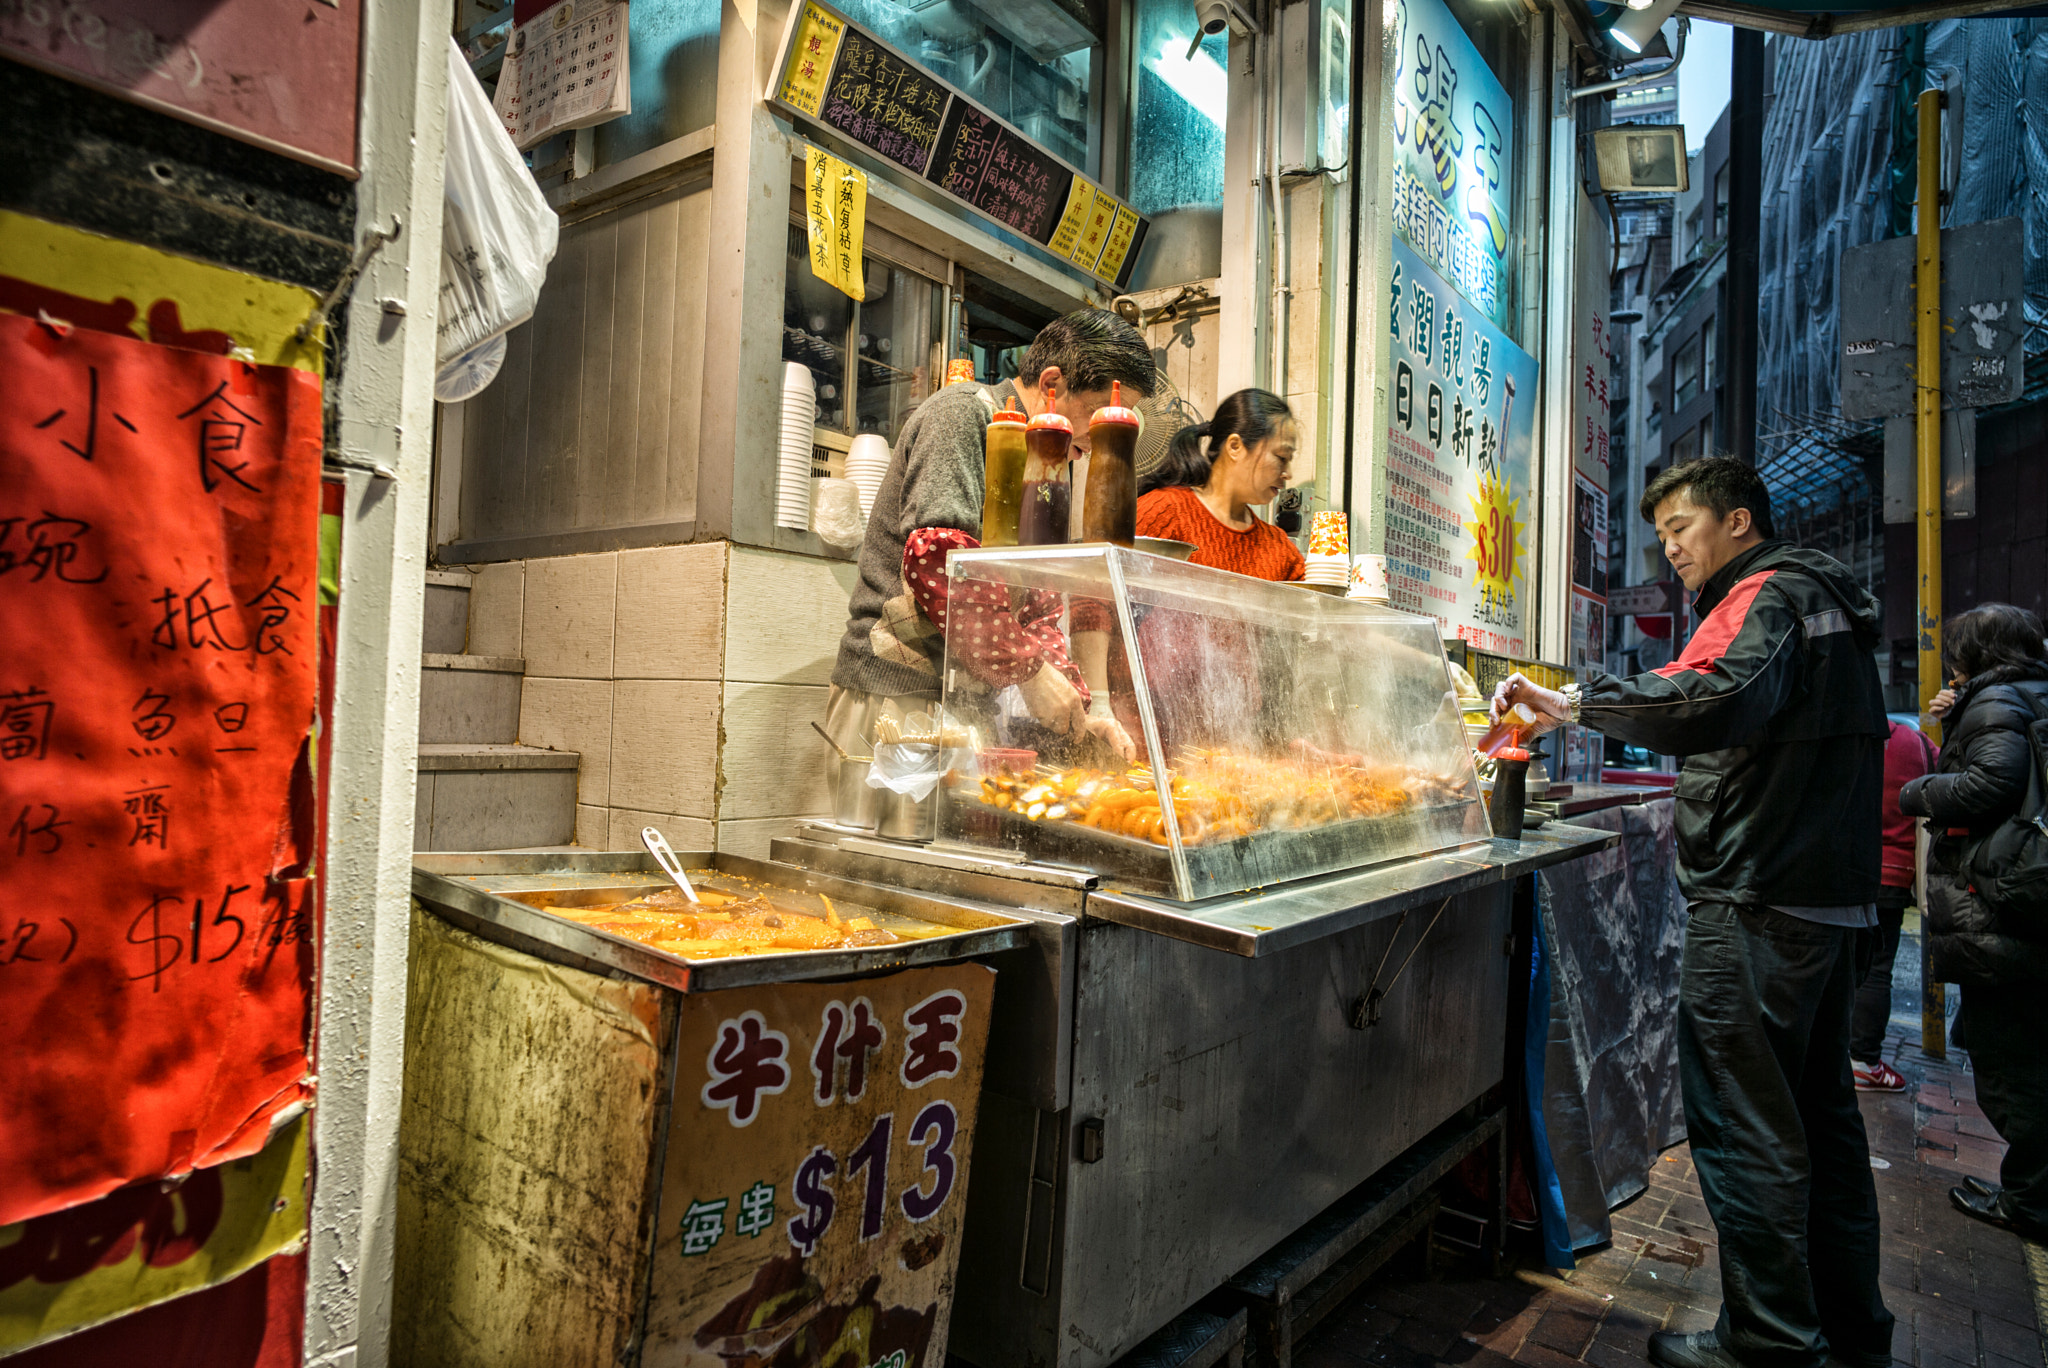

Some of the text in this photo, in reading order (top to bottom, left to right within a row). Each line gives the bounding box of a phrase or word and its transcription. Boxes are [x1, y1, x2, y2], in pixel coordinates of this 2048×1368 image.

[556, 57, 563, 66] 10
[571, 48, 578, 58] 11
[588, 42, 596, 51] 12
[605, 34, 614, 44] 13
[590, 24, 596, 33] 5
[801, 34, 821, 79] 靚湯
[506, 112, 519, 120] 21
[538, 98, 546, 108] 23
[552, 90, 558, 100] 24
[566, 83, 575, 92] 25
[584, 77, 594, 86] 26
[601, 69, 610, 80] 27
[540, 82, 547, 90] 16
[554, 73, 560, 82] 17
[568, 66, 576, 75] 18
[586, 60, 595, 69] 19
[603, 52, 612, 62] 20
[505, 127, 516, 136] 28
[994, 140, 1051, 192] 純手工製作
[1394, 3, 1506, 259] 湯王
[811, 152, 828, 269] 消暑五花茶
[34, 366, 263, 493] 小食
[1396, 360, 1498, 480] 日日新款
[1478, 507, 1513, 583] $30
[151, 575, 302, 656] 抵食
[701, 989, 966, 1127] 牛什王
[787, 1099, 958, 1257] $13
[681, 1181, 775, 1257] 每串
